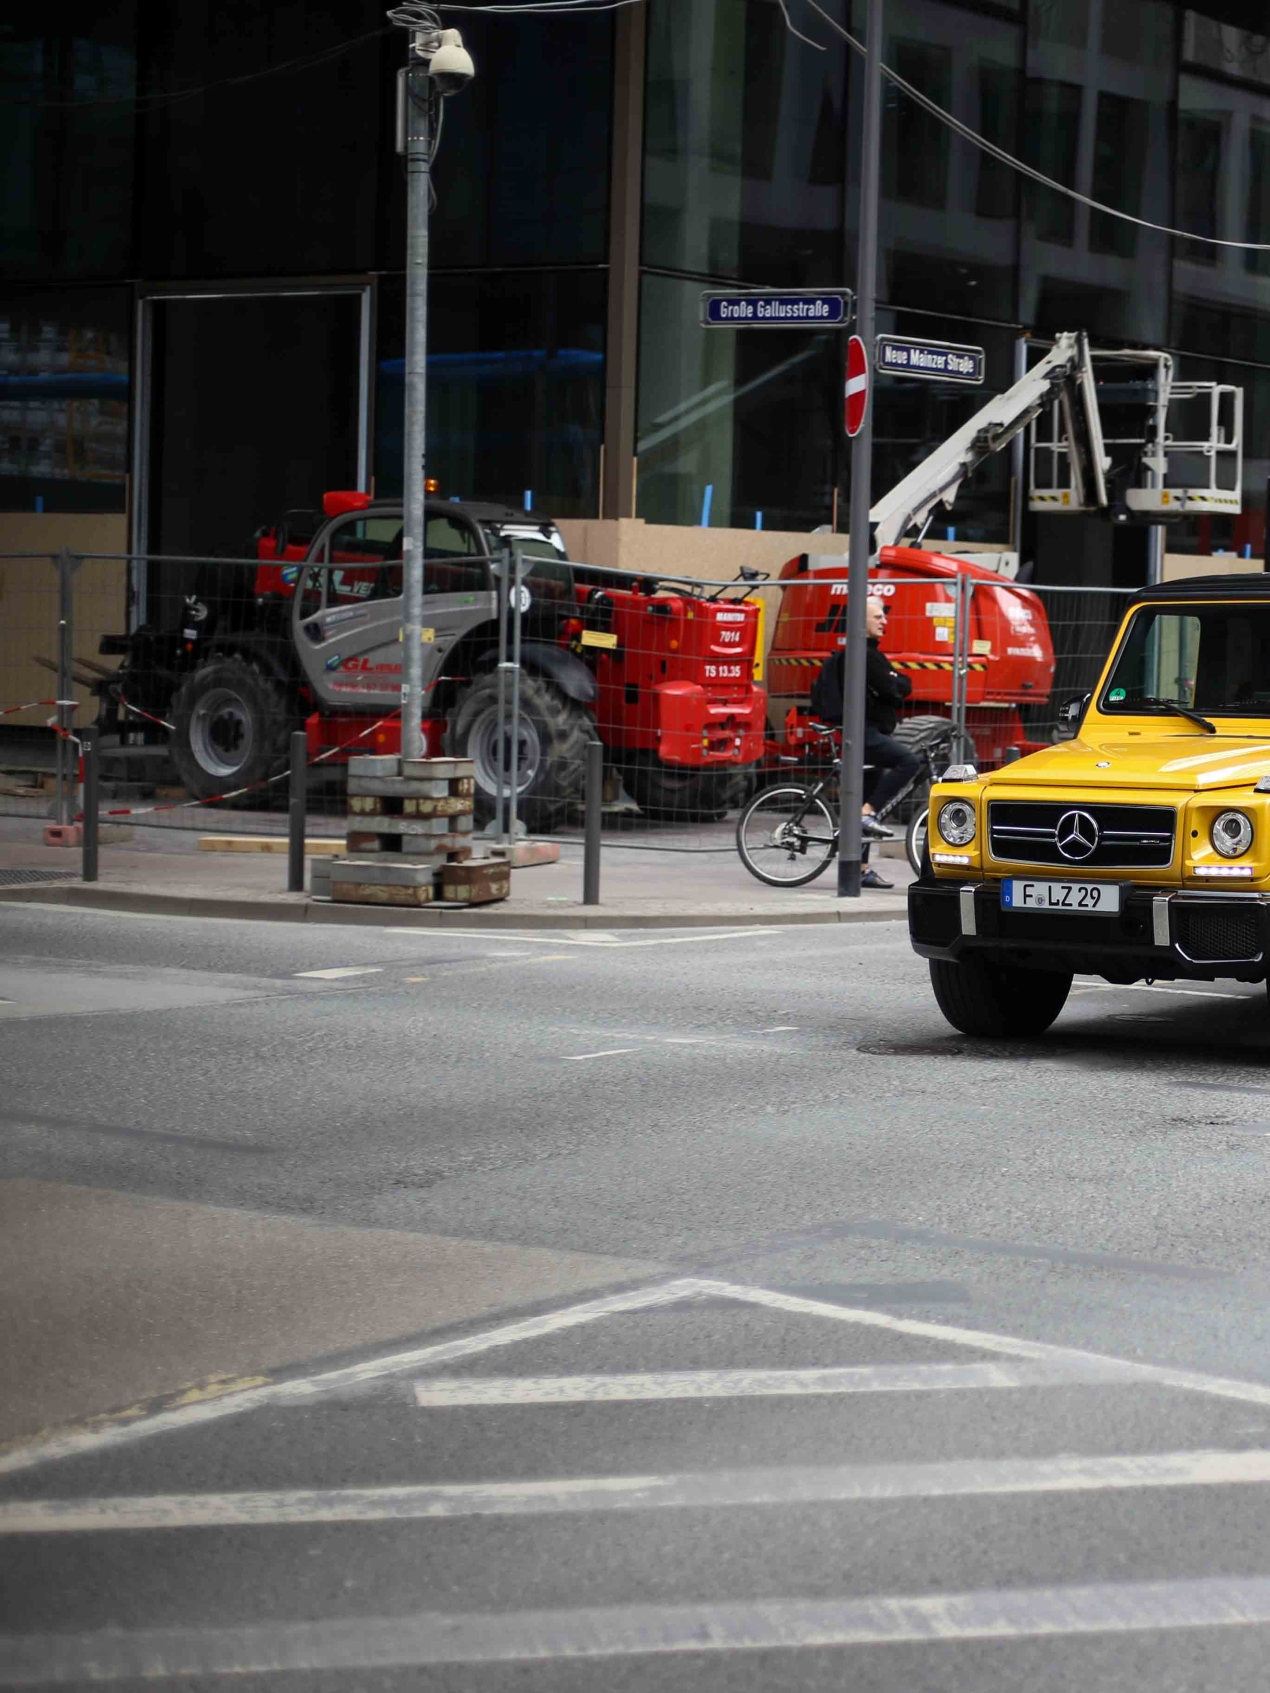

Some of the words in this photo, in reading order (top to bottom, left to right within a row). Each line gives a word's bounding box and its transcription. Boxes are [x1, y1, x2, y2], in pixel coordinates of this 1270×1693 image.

[720, 301, 753, 318] Große
[757, 300, 829, 318] Gallusstraße
[885, 345, 908, 364] Neue
[910, 348, 946, 369] Mainzer
[947, 353, 974, 374] Straße
[719, 631, 741, 643] 7014
[704, 664, 717, 678] TS
[718, 665, 741, 678] 13.35
[1023, 884, 1035, 905] F
[1048, 885, 1073, 907] LZ
[1078, 887, 1101, 908] 29
